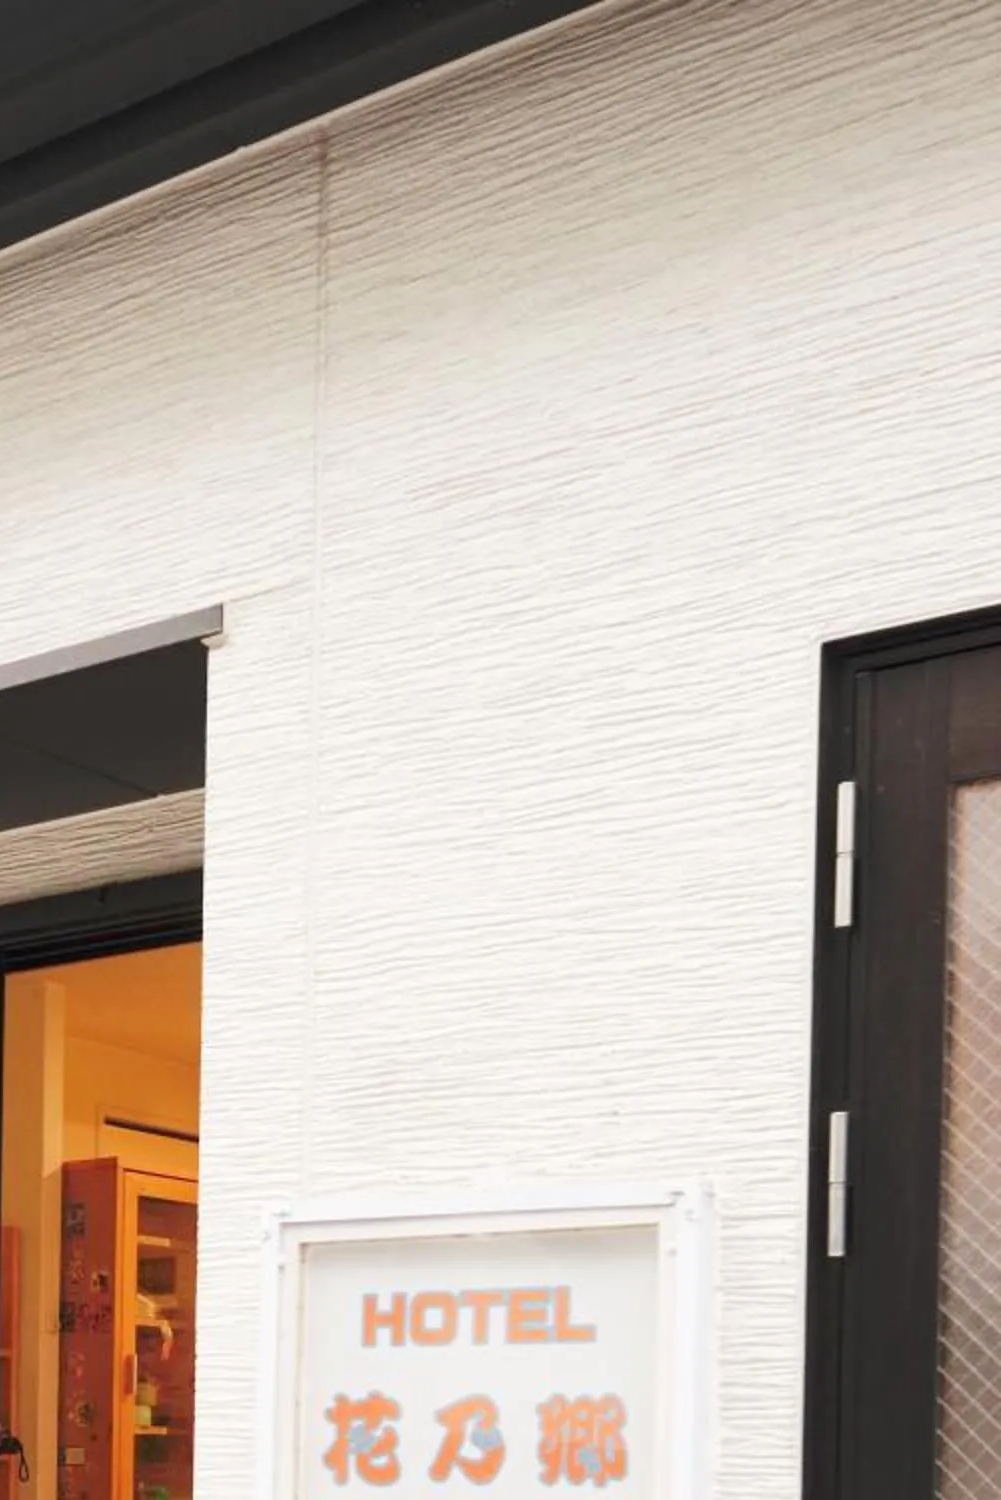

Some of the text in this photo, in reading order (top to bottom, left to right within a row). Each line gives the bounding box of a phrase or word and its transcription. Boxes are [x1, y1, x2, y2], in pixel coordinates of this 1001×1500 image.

[361, 1286, 596, 1347] HOTEL
[322, 1391, 628, 1487] 花乃郷
